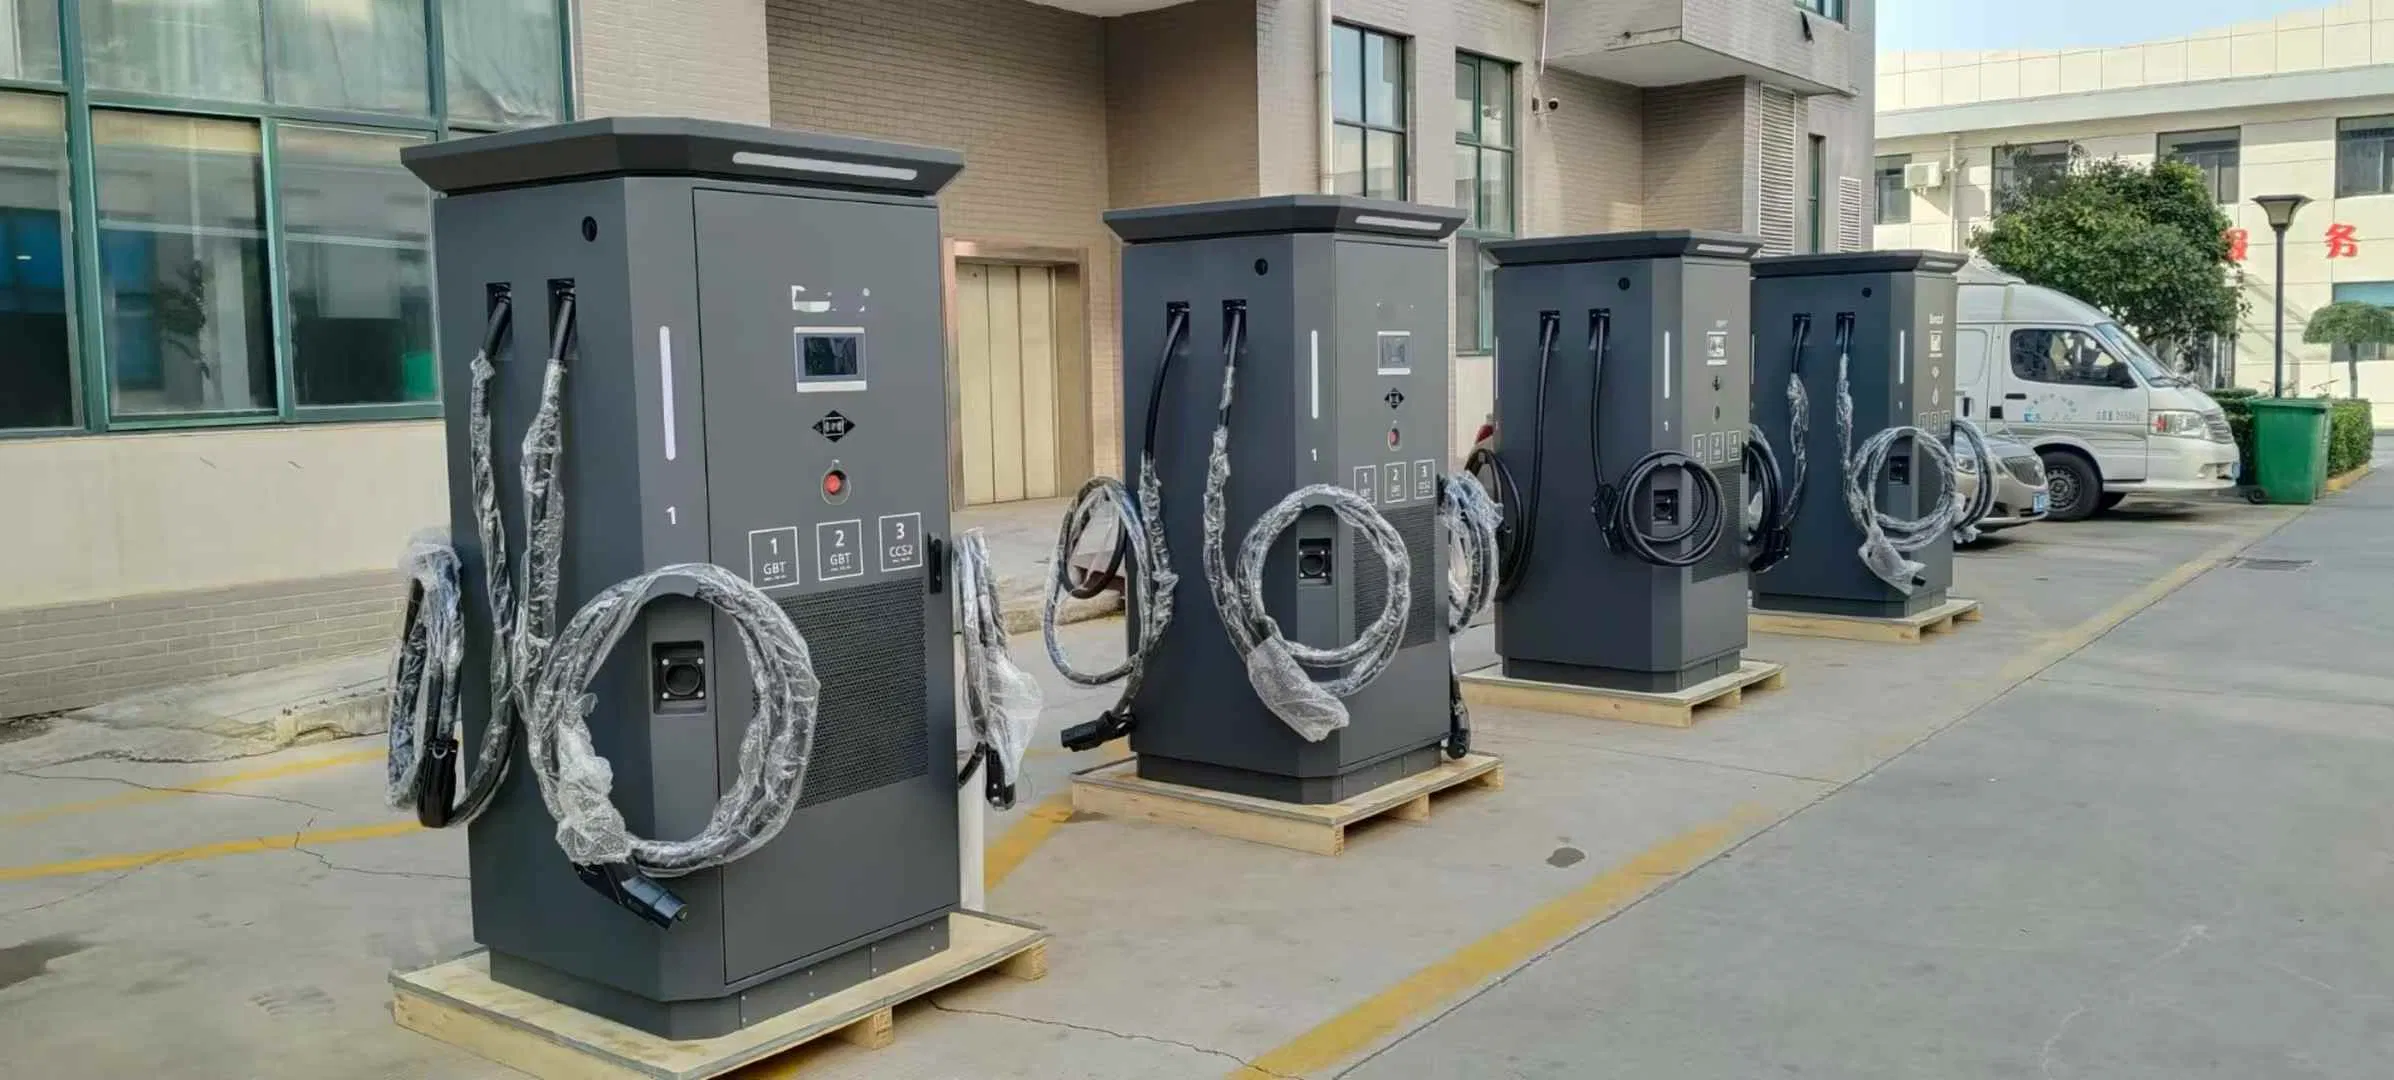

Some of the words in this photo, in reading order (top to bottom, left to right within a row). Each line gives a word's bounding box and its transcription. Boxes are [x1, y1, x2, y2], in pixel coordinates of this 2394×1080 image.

[1311, 448, 1318, 462] 1
[1363, 472, 1368, 484] 1
[665, 506, 677, 525] 1
[895, 522, 905, 540] 3
[834, 529, 845, 548] 2
[769, 537, 778, 556] 1
[889, 544, 913, 558] CCS2
[830, 552, 852, 566] GBT
[763, 561, 787, 575] GBT
